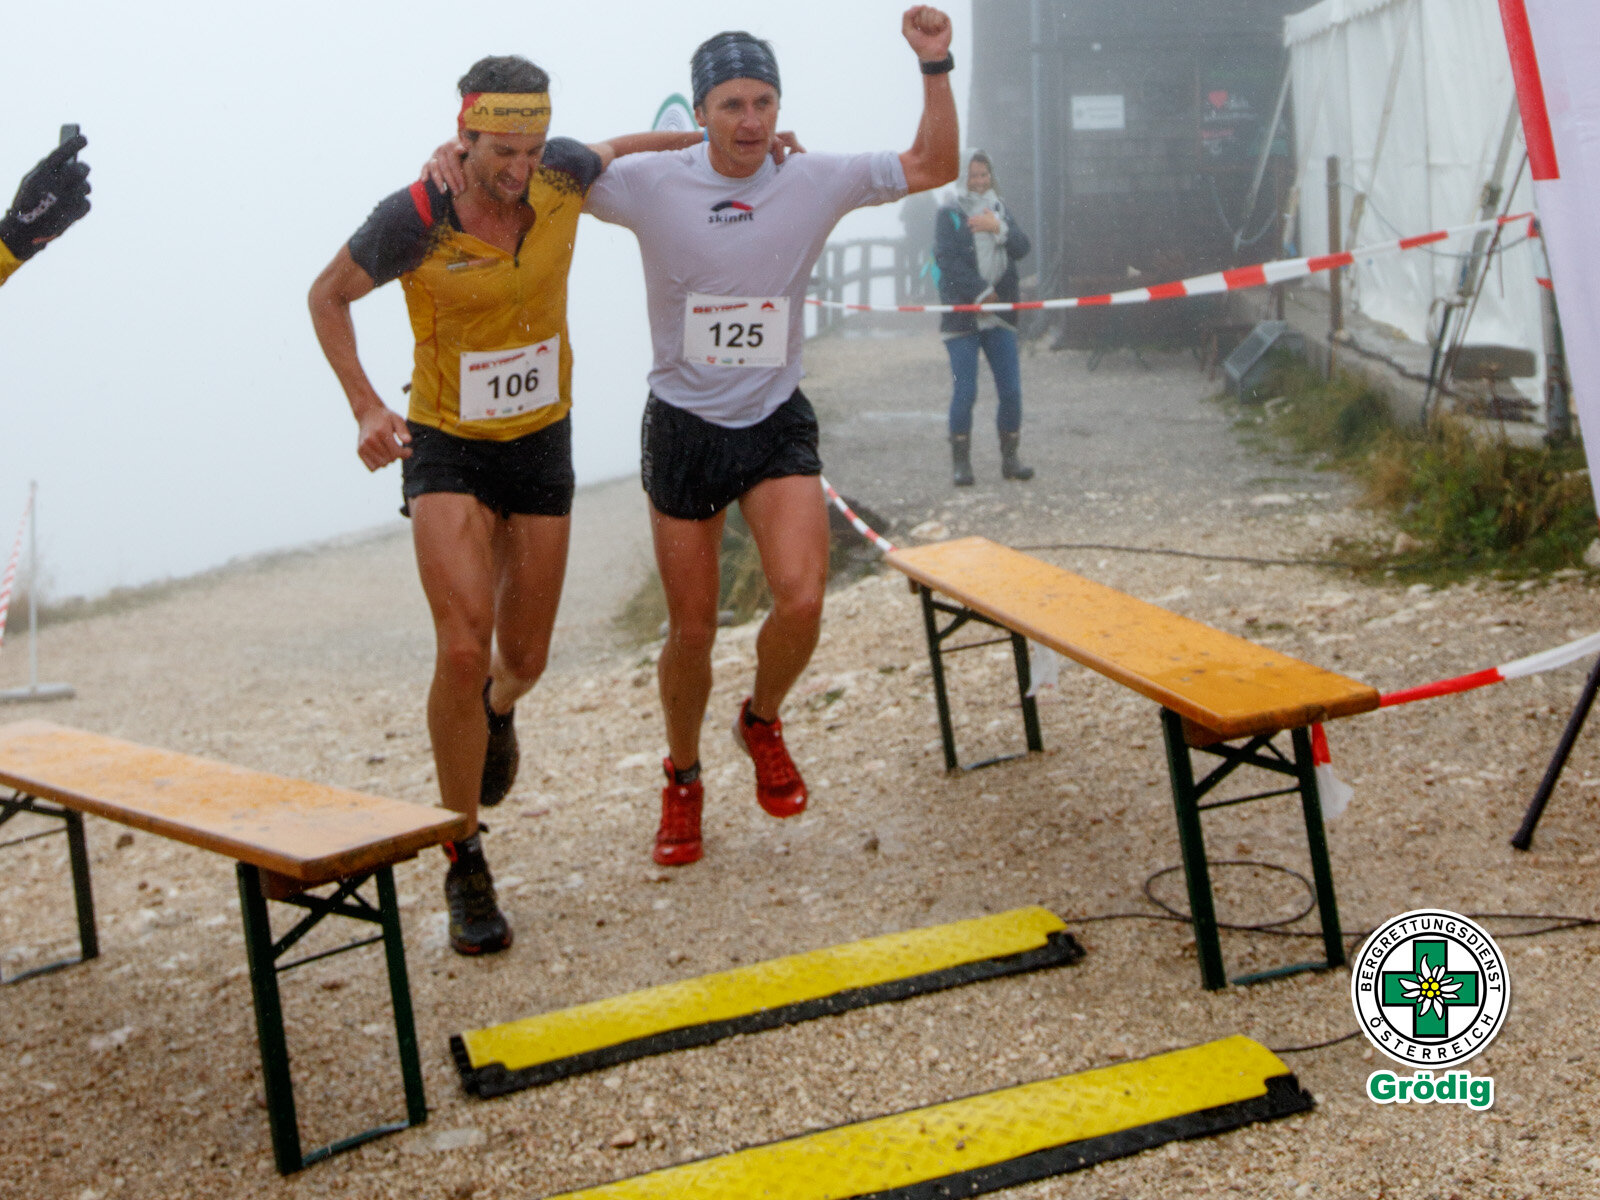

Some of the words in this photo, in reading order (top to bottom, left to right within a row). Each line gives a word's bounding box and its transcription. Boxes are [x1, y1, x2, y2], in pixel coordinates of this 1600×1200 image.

[472, 106, 489, 115] LA
[708, 212, 754, 223] skinfit
[709, 322, 763, 348] 125
[487, 368, 538, 399] 106
